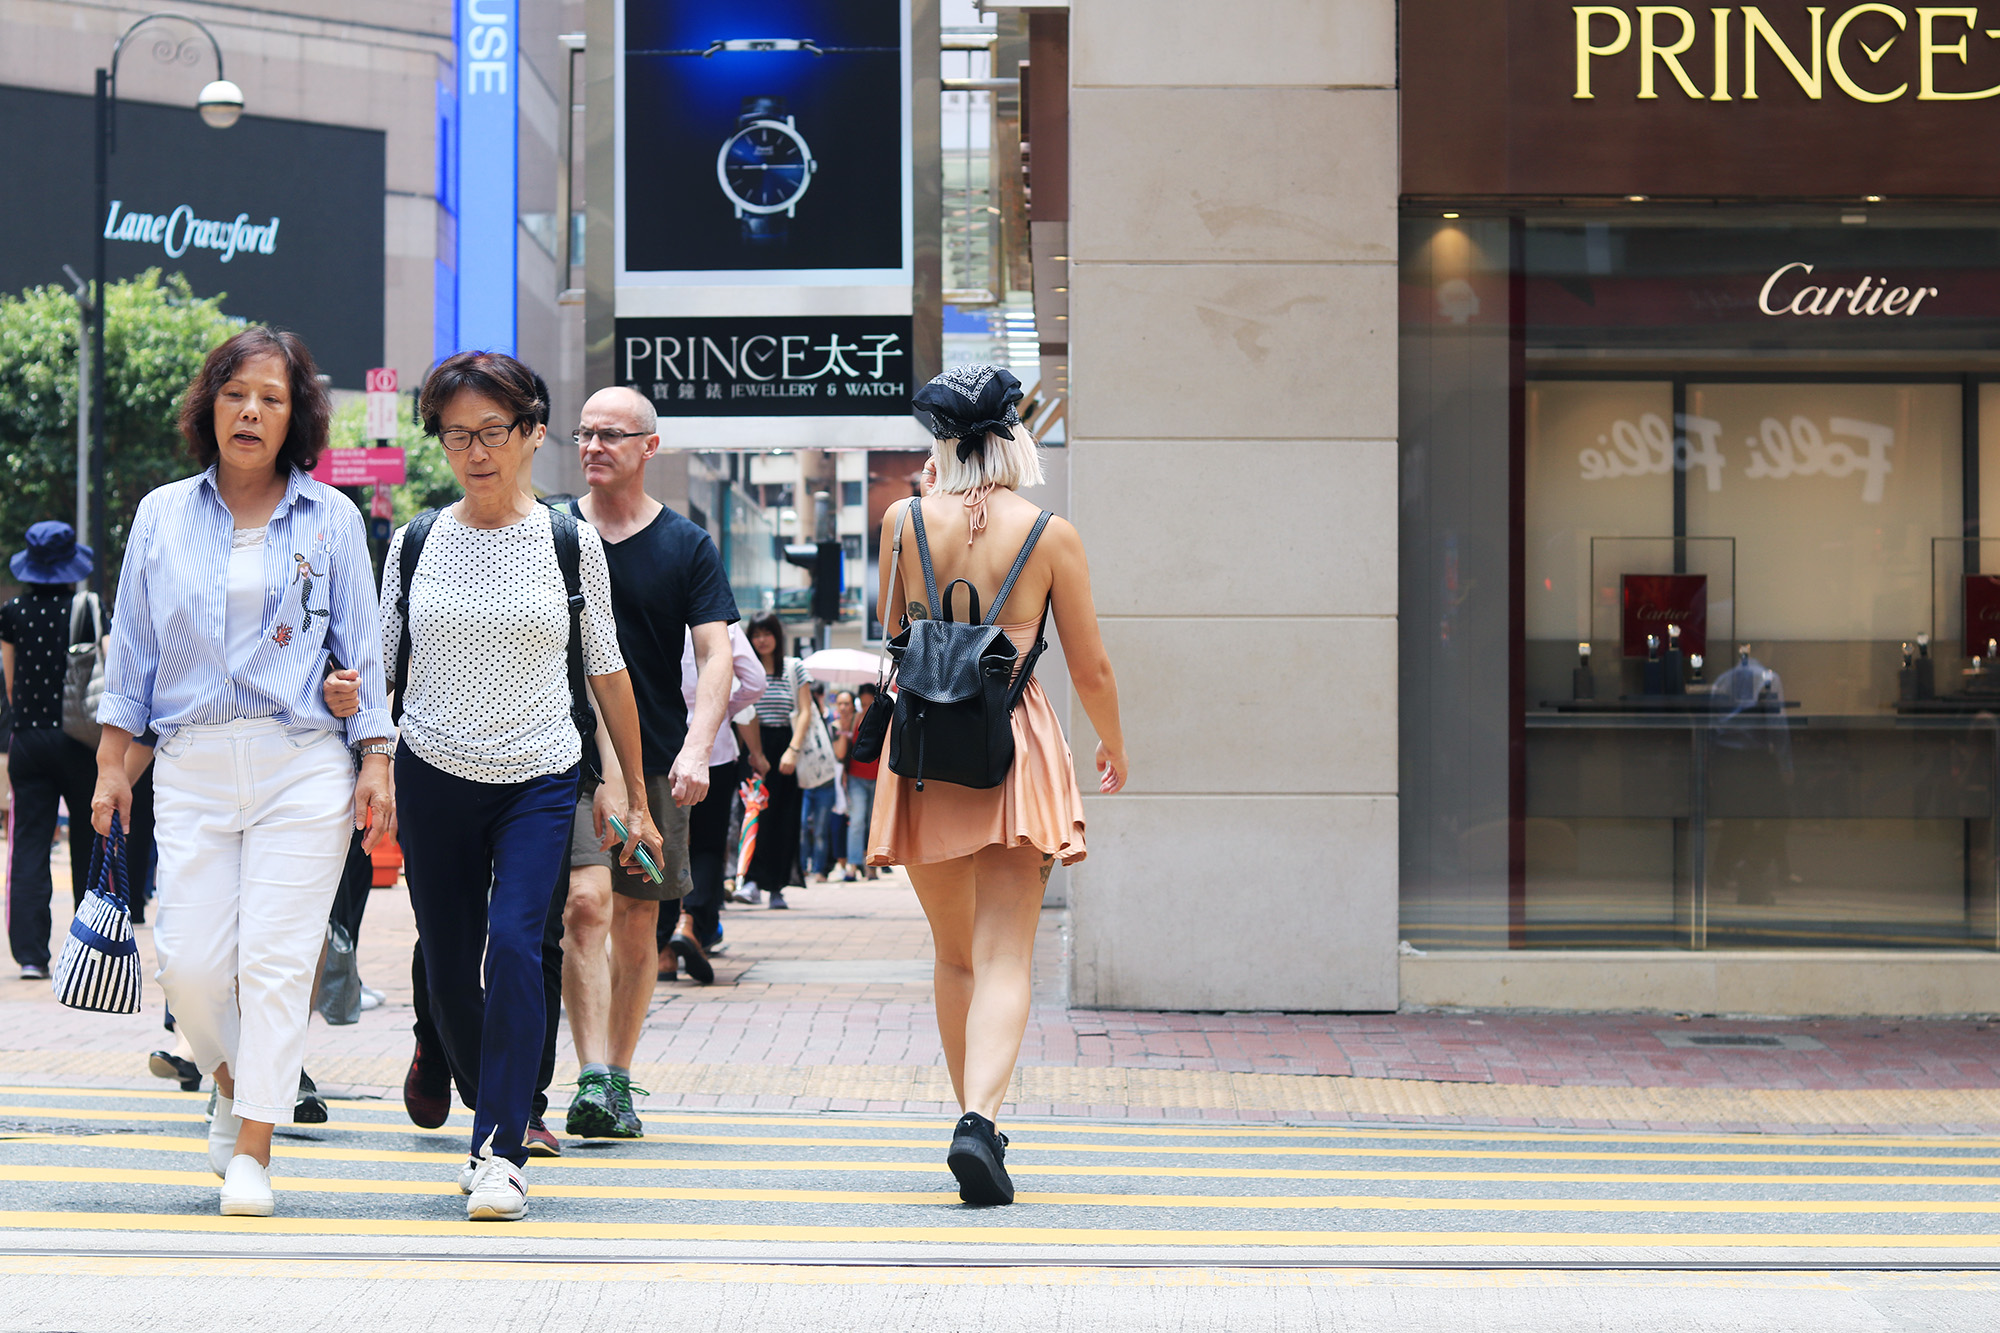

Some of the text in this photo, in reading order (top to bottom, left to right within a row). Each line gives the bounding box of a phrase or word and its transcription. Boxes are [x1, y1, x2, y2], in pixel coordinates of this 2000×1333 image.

[1572, 3, 2000, 103] PRINCE
[103, 200, 280, 263] Lane Crawford
[1758, 262, 1938, 316] Cartier
[625, 333, 904, 381] PRINCE 太子
[731, 383, 818, 398] JEWELLERY
[827, 383, 837, 396] &
[845, 383, 904, 397] WATCH
[1637, 603, 1691, 620] Cartier
